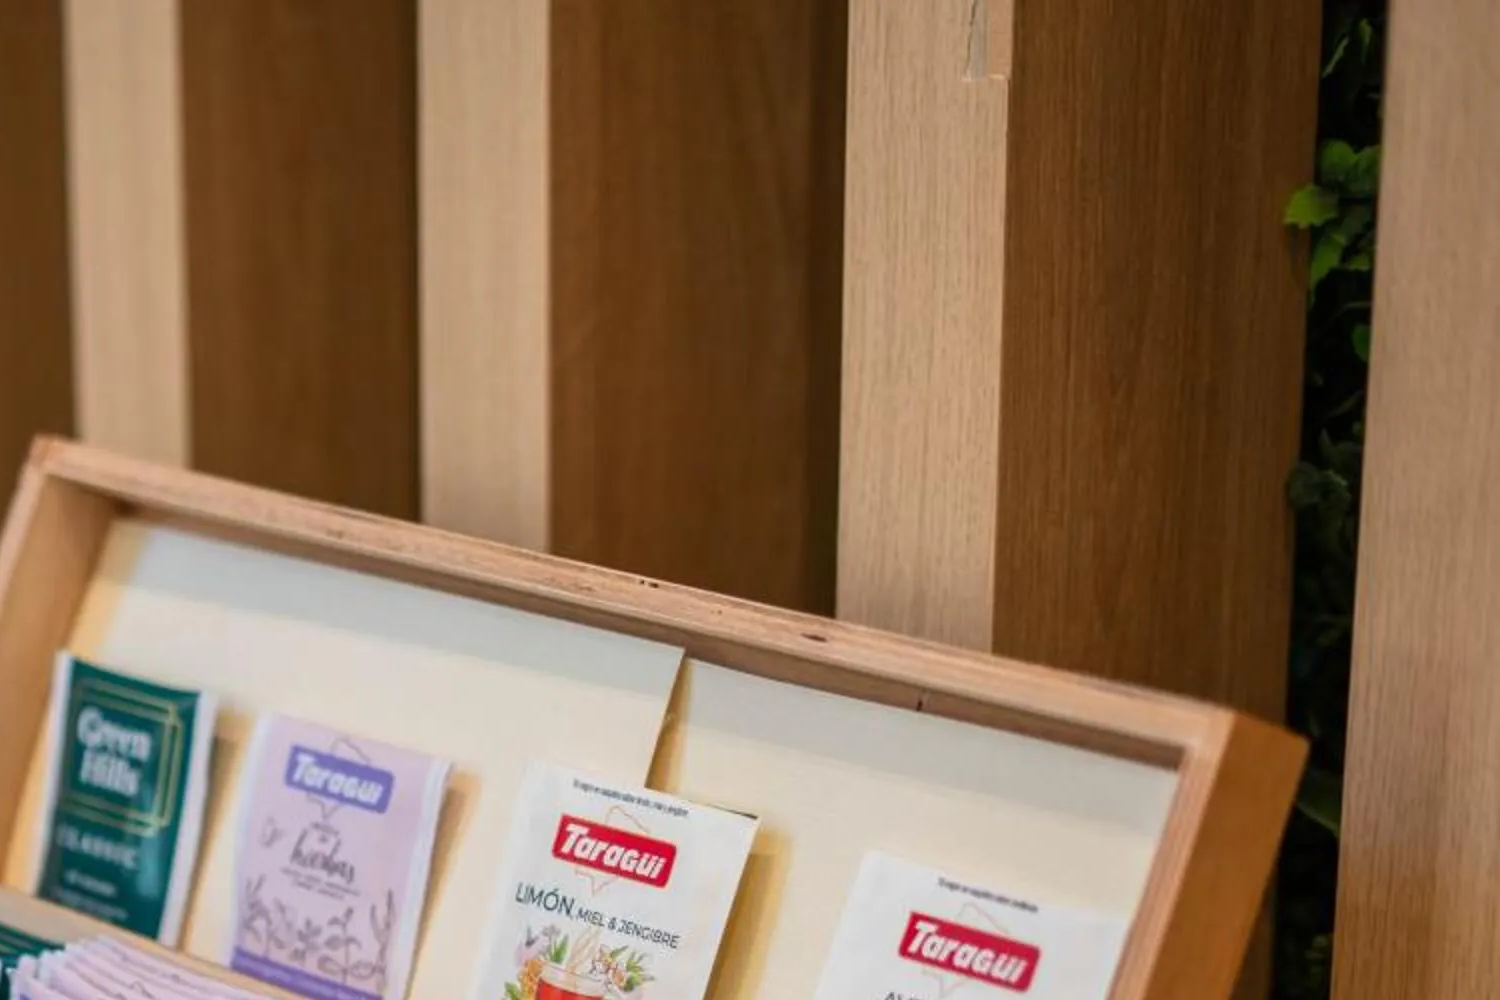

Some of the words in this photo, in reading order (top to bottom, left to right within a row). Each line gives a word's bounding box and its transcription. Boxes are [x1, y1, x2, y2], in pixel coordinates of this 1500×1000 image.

[77, 706, 152, 763] Green
[80, 747, 140, 797] Hills
[577, 906, 605, 928] MIEL
[607, 917, 618, 931] &
